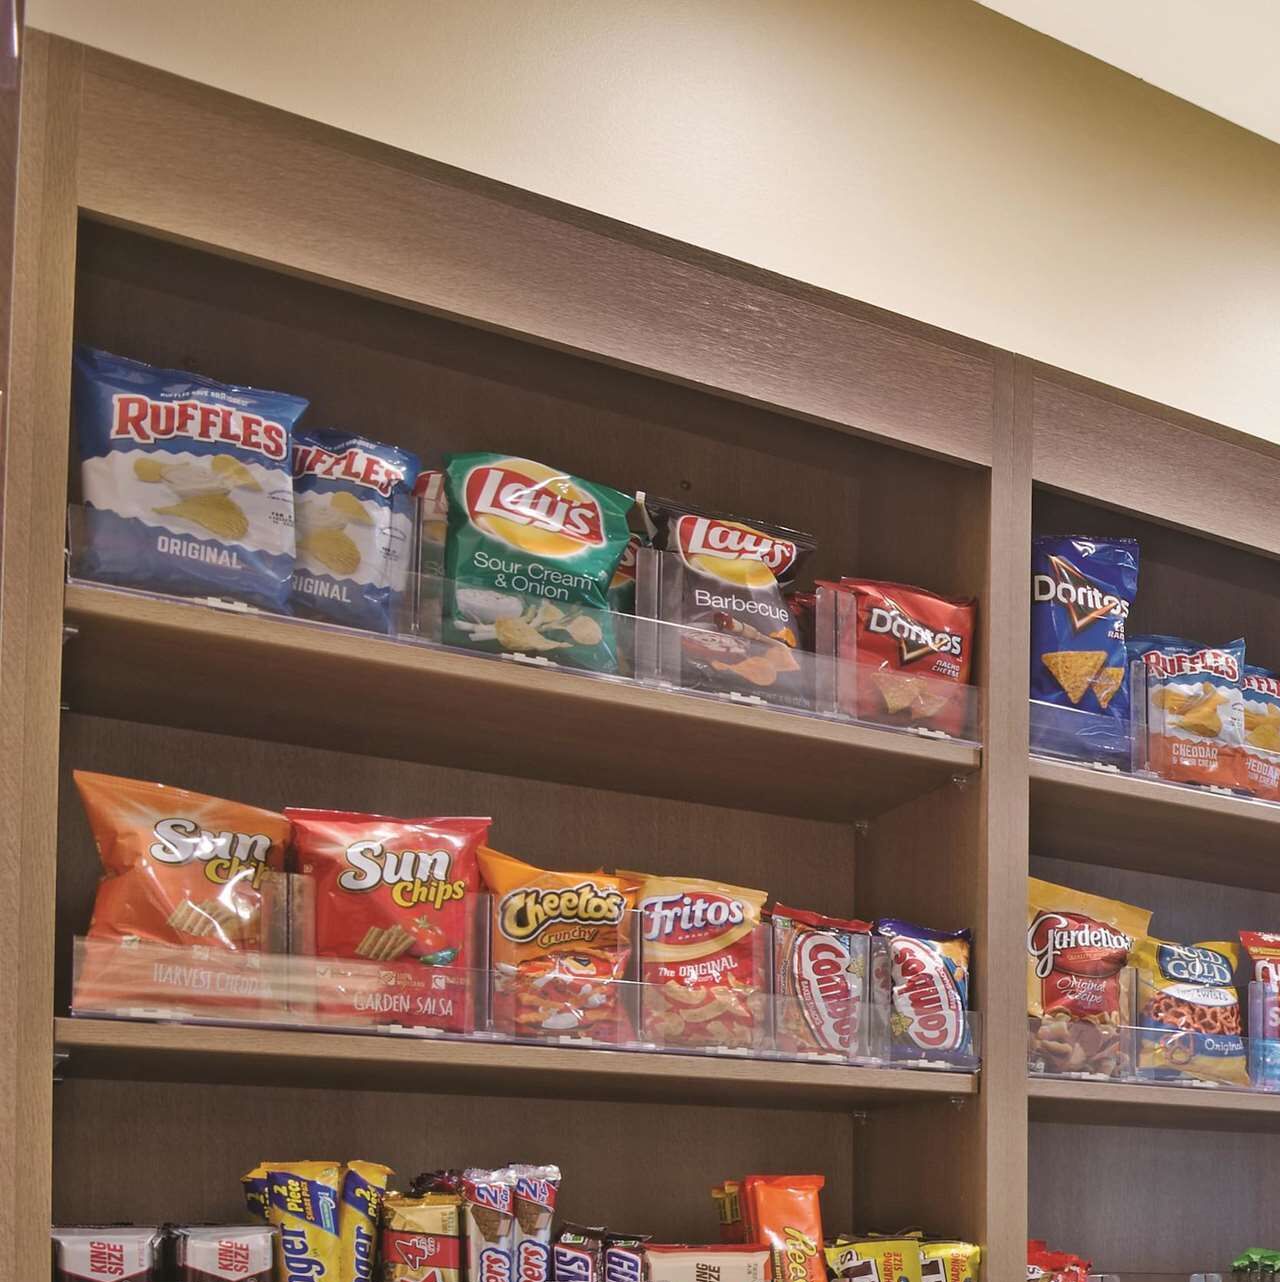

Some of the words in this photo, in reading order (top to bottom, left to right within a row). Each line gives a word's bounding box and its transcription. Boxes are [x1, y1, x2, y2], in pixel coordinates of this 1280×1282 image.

[114, 395, 287, 459] RUFFLES
[470, 469, 596, 534] Lay's
[157, 537, 242, 570] ORIGINAL
[687, 519, 792, 567] Lay's
[473, 552, 524, 573] Sour
[528, 563, 592, 588] Cream
[494, 574, 508, 588] &
[510, 575, 569, 601] Onion
[1034, 575, 1130, 618] Doritos
[695, 590, 790, 623] Barbecue
[1143, 649, 1238, 682] RUFFLES
[1172, 744, 1218, 758] CHEDDAR
[150, 818, 271, 863] Sun
[338, 841, 450, 891] Sun
[393, 879, 464, 909] Chips
[500, 884, 625, 941] Cheetos
[642, 892, 743, 941] Fritos
[538, 926, 596, 947] Crunchy
[1056, 975, 1106, 997] Original
[1167, 961, 1231, 982] GOLD
[354, 992, 410, 1013] GARDEN
[416, 998, 453, 1017] SALSA
[1204, 1039, 1244, 1055] Original
[91, 1241, 107, 1273] KING
[108, 1243, 124, 1275] SIZE
[217, 1240, 233, 1272] KING
[234, 1242, 249, 1273] SIZE
[894, 1251, 903, 1271] SIZE
